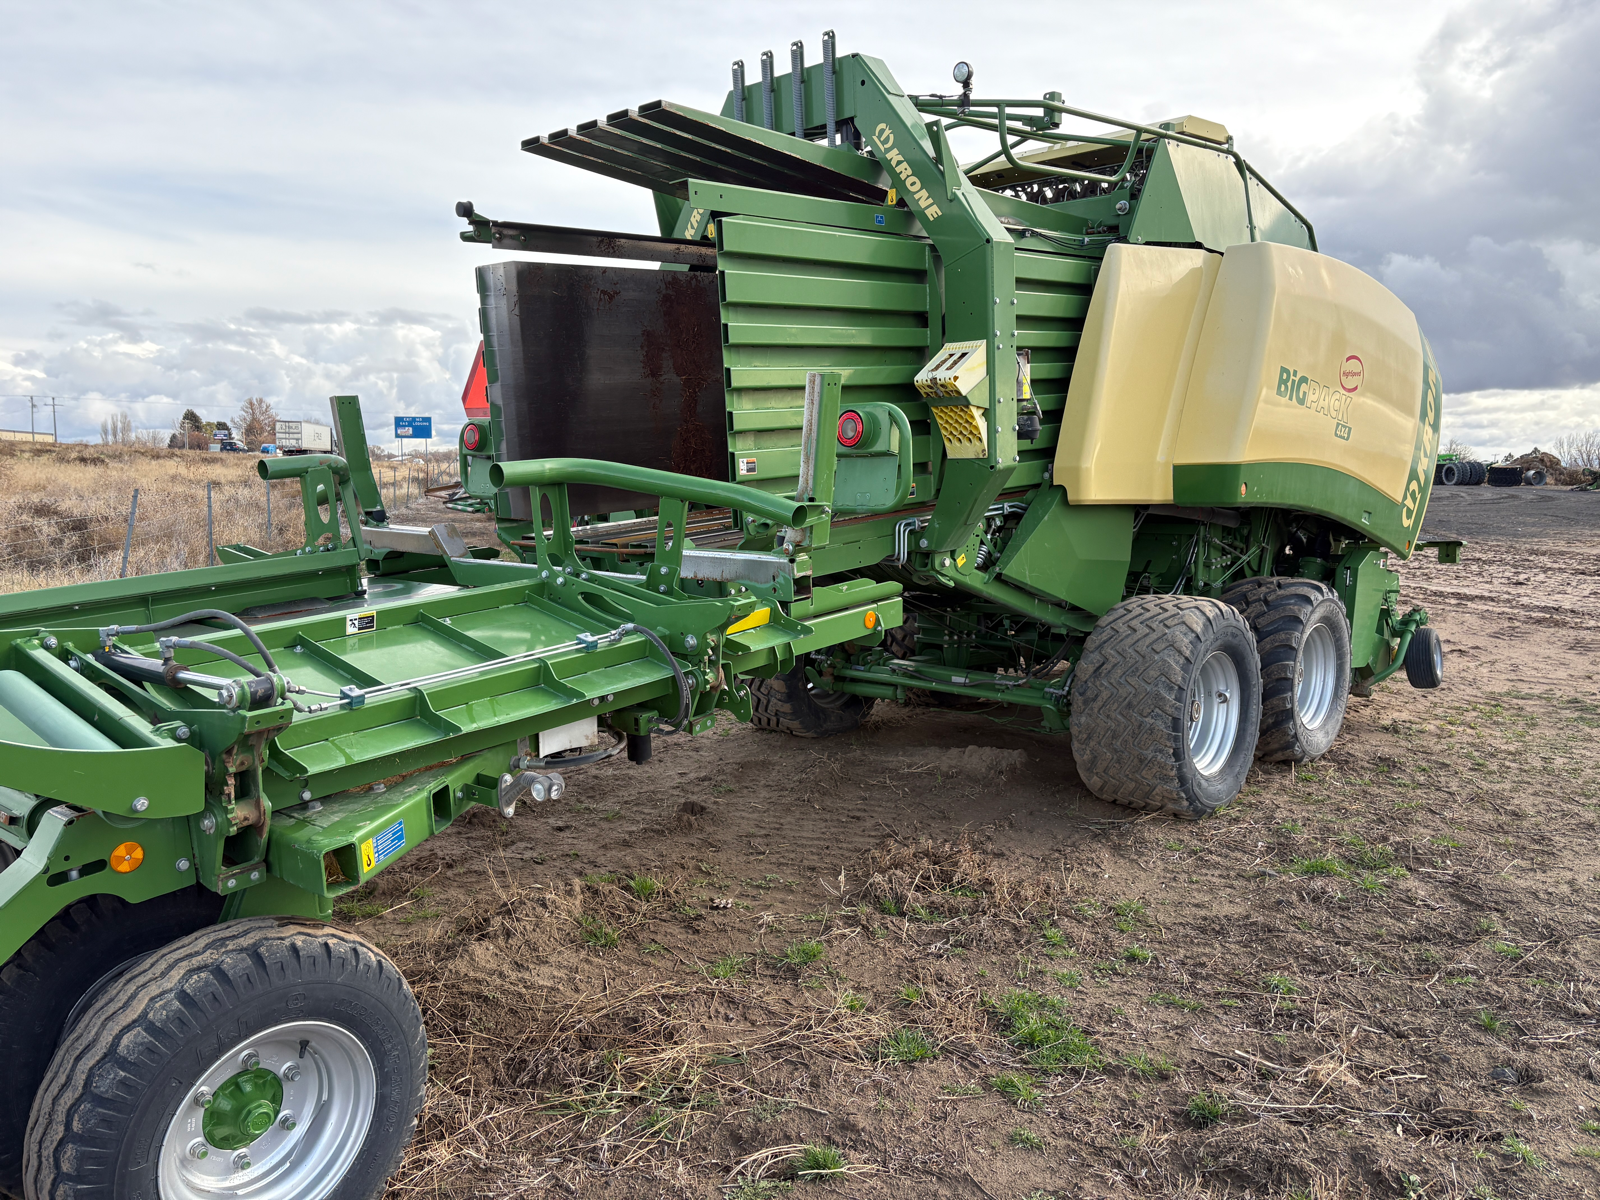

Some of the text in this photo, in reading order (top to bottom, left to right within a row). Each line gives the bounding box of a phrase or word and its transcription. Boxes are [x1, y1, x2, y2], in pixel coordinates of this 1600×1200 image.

[885, 147, 943, 222] KRONE
[1342, 369, 1362, 380] HighSpeed
[1336, 424, 1350, 440] 4x4
[334, 998, 401, 1064] IMPLEMENT
